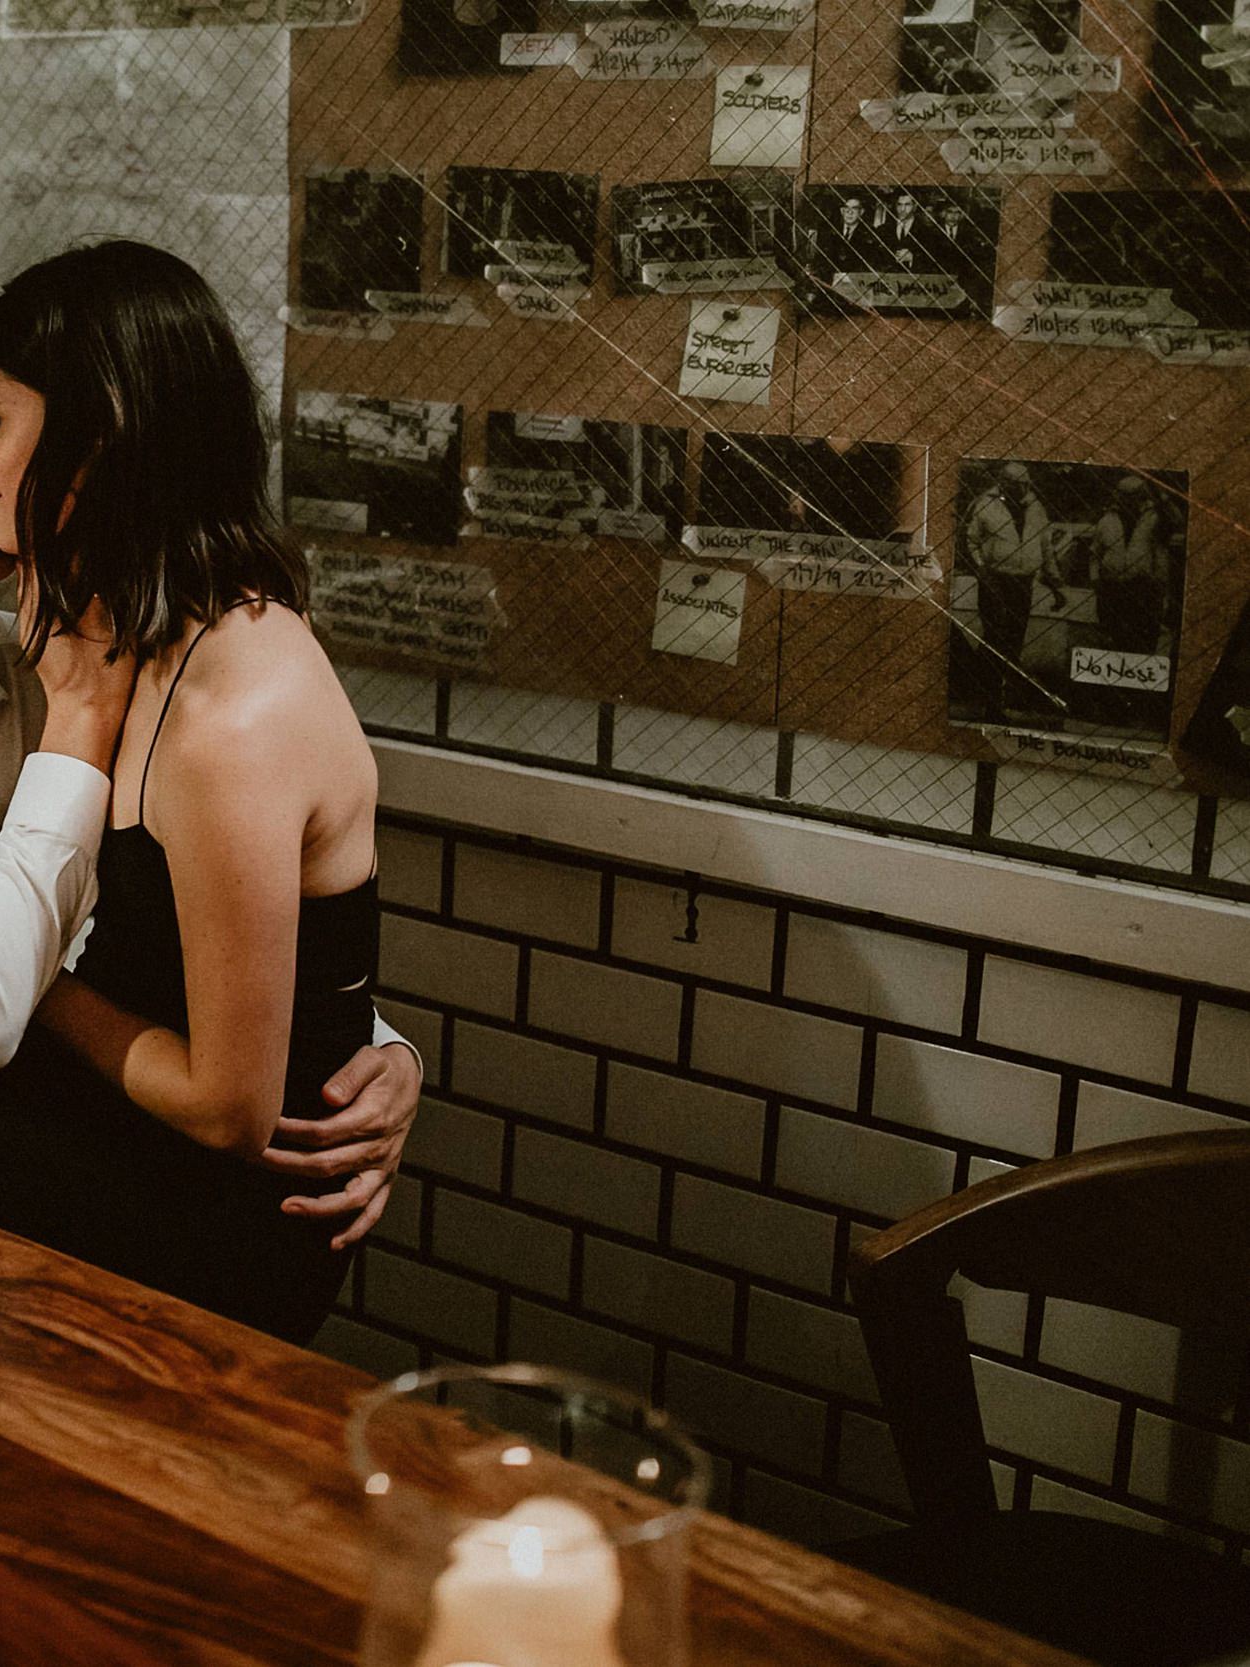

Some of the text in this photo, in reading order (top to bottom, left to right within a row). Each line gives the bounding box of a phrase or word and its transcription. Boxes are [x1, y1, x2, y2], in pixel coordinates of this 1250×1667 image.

[721, 91, 801, 114] SOLDIERS
[691, 333, 755, 357] STREET
[686, 355, 772, 378] ENFORCERS
